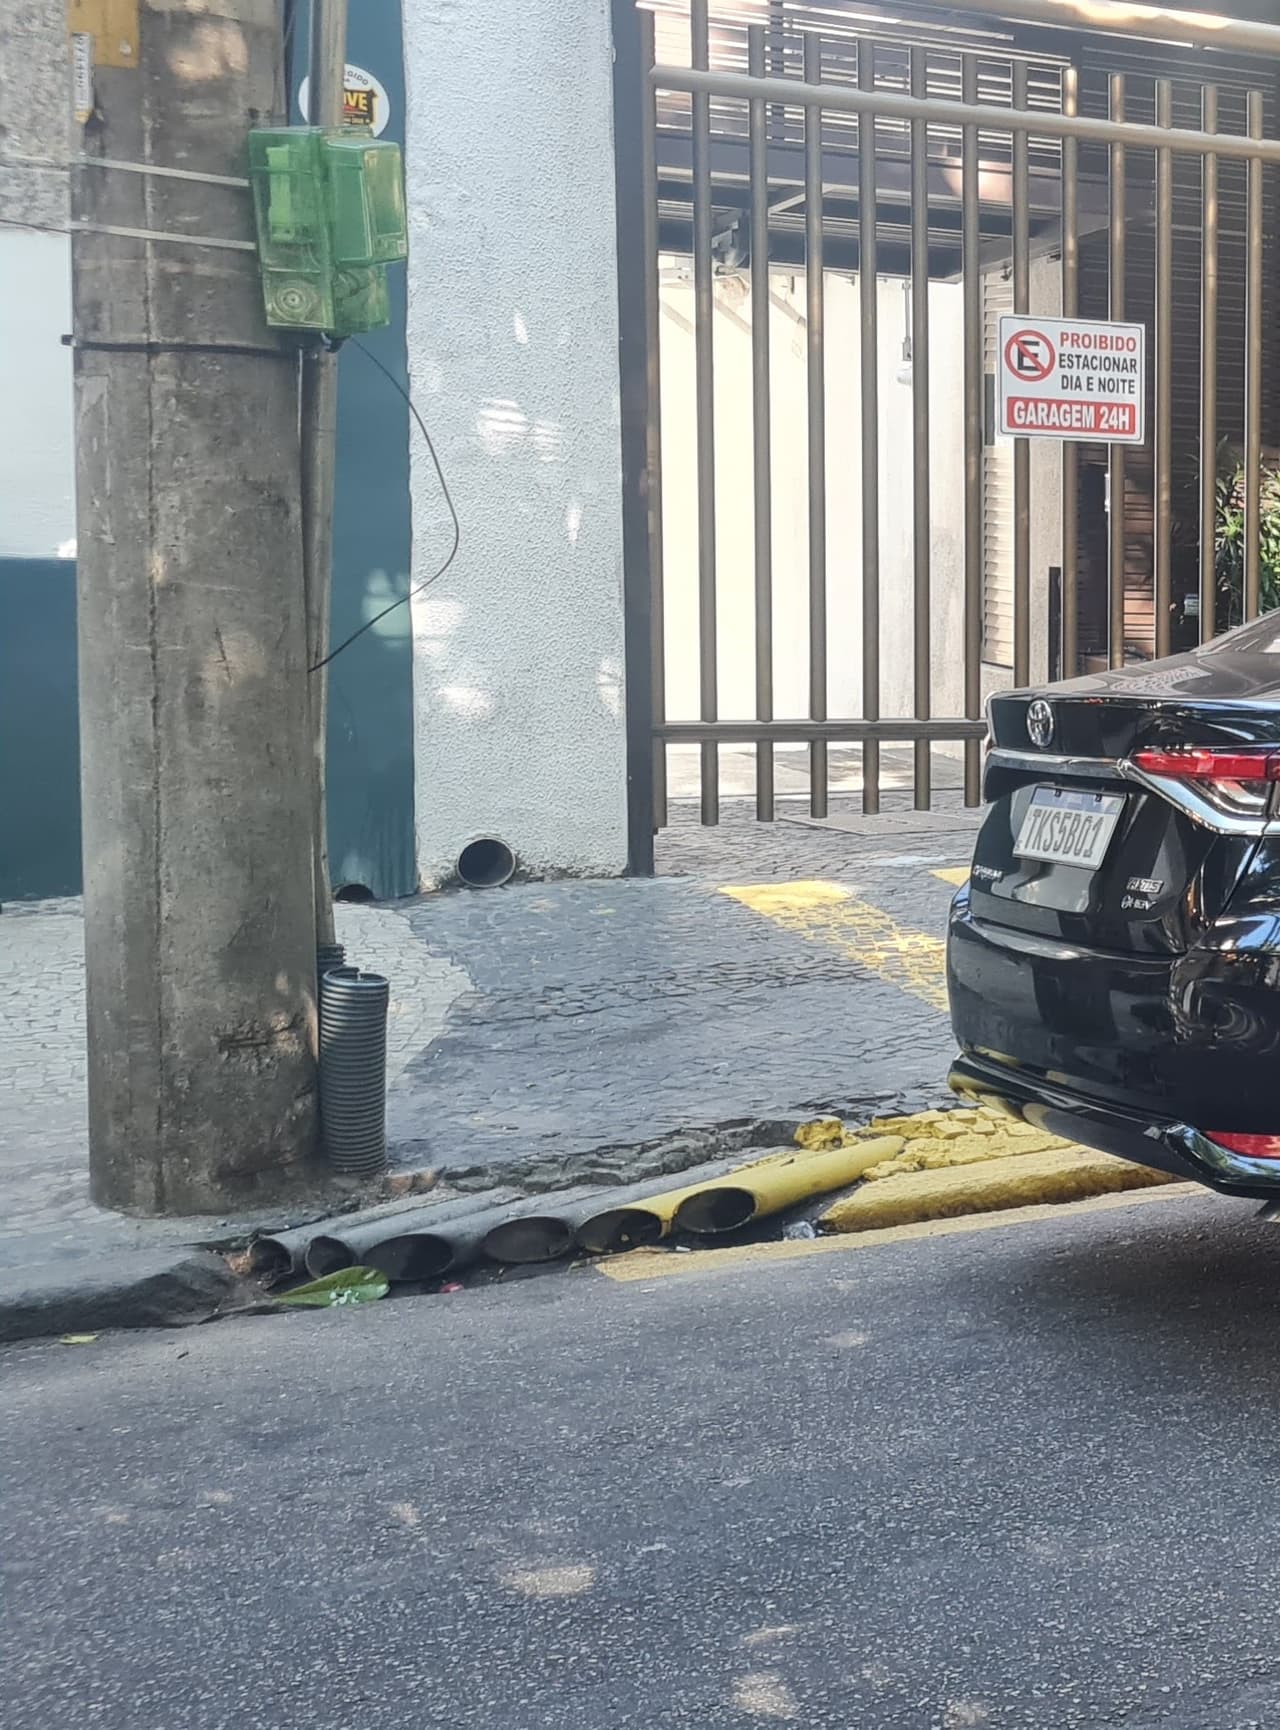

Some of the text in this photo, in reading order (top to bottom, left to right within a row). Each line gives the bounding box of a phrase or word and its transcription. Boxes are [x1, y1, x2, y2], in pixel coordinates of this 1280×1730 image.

[1060, 332, 1137, 353] PROIBIDO
[1059, 353, 1137, 374] ESTACIONAR
[1061, 374, 1136, 395] DIA E NOITE
[1013, 400, 1130, 431] GARAGEM 24H
[1025, 808, 1104, 858] TKS5B01
